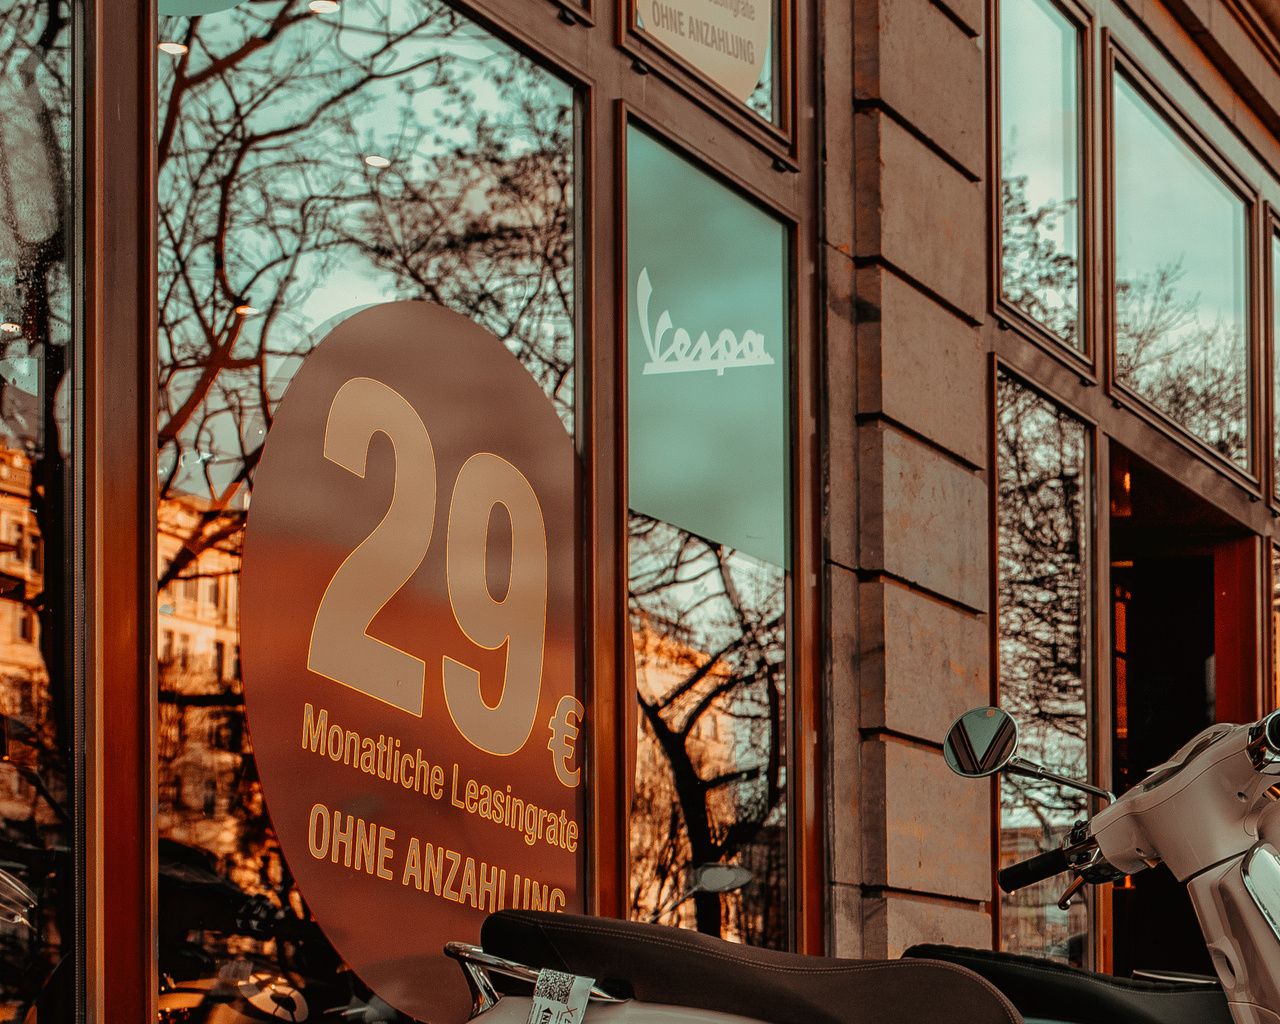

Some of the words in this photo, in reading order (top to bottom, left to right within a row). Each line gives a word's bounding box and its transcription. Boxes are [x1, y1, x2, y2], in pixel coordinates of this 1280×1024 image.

[652, 2, 685, 37] OHNE
[688, 15, 756, 65] ANZAHLUNG
[637, 266, 775, 376] Vespa
[302, 703, 444, 800] Monatliche
[451, 763, 579, 852] Leasingrate
[308, 803, 396, 881] OHNE
